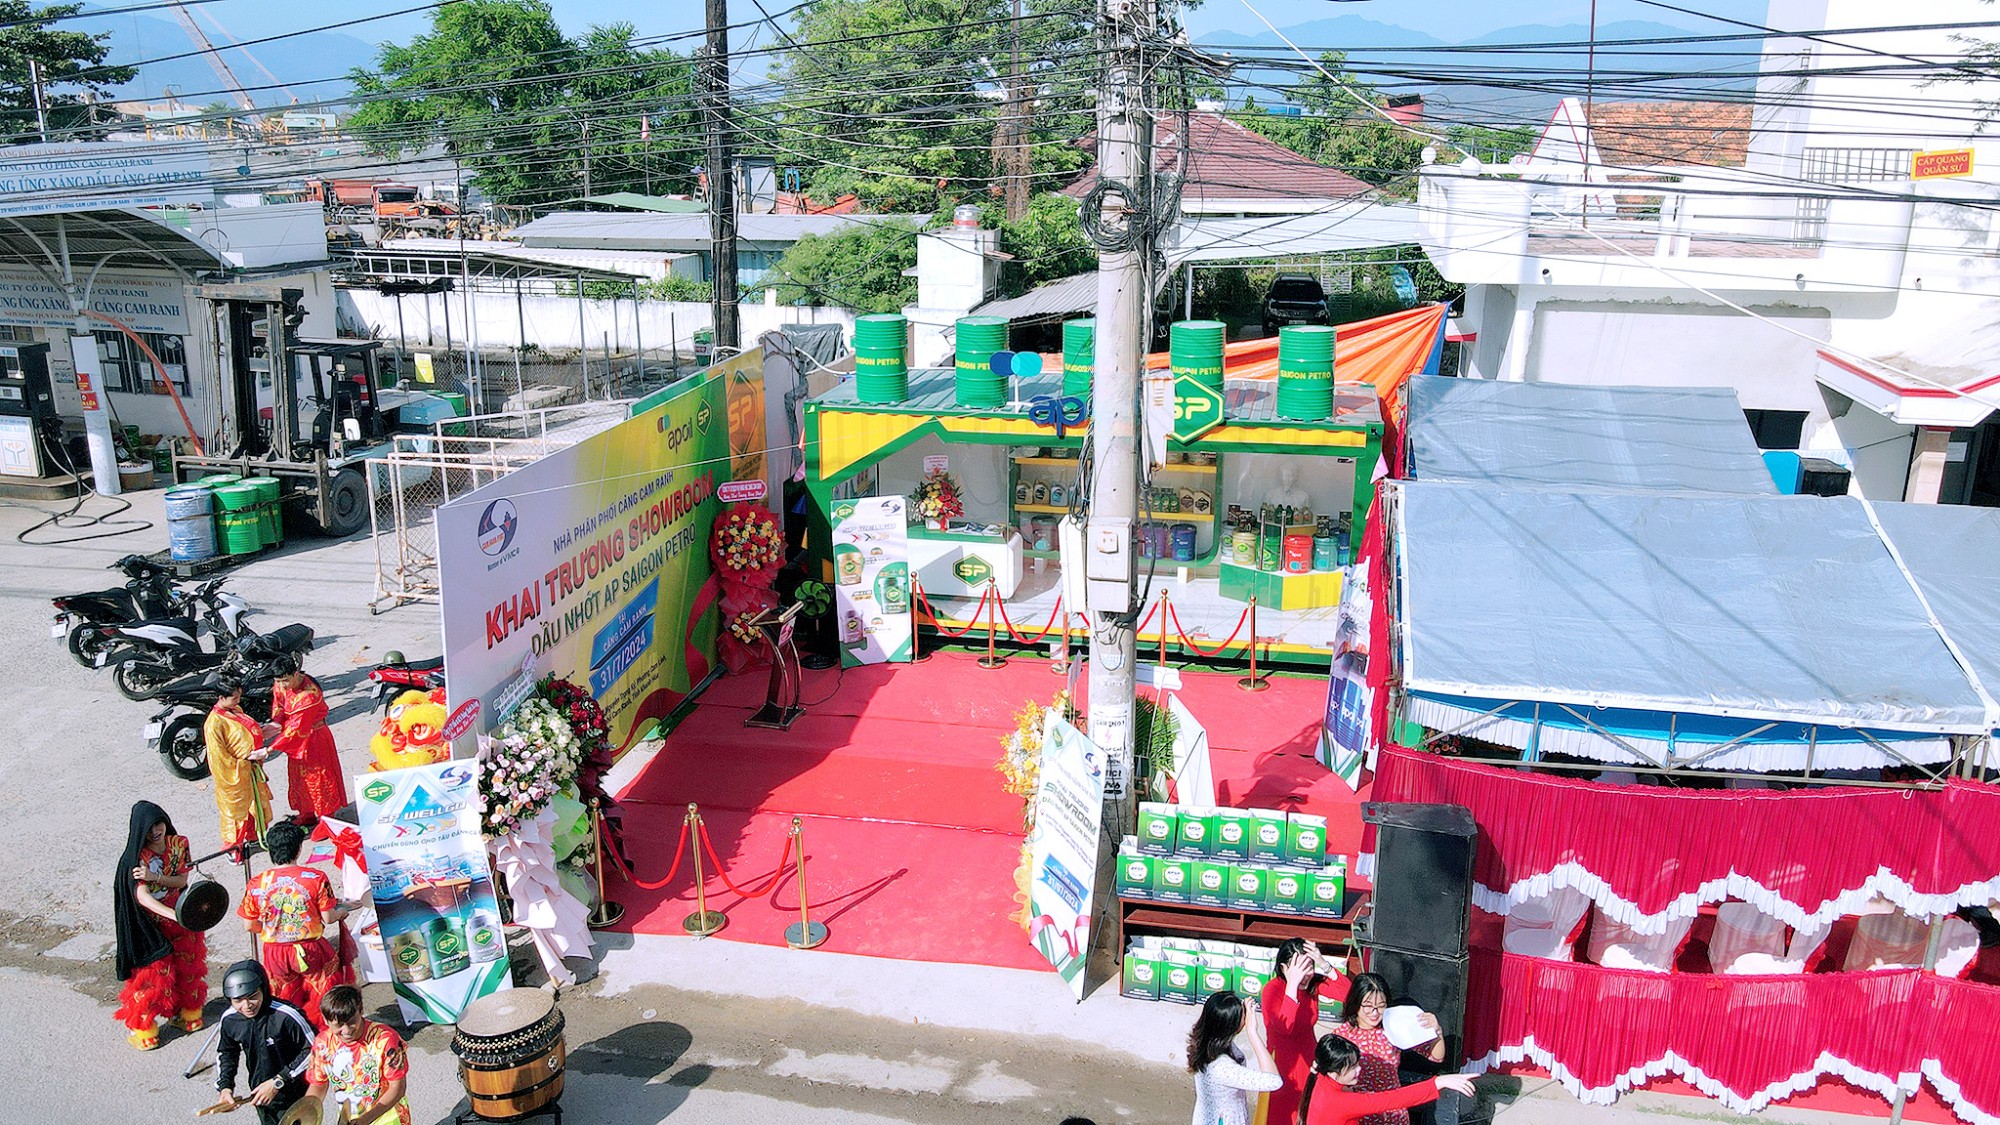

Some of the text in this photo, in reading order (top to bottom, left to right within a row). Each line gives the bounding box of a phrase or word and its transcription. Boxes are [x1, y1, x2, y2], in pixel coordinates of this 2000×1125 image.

[1936, 155, 1967, 165] QUANG
[1923, 164, 1962, 175] QUÂN SỰ
[0, 179, 16, 192] NG
[19, 175, 47, 191] ỨNG
[48, 174, 84, 188] XĂNG
[121, 289, 149, 297] RANH
[0, 297, 17, 308] NG
[95, 298, 123, 313] CẢNG
[125, 303, 148, 314] CAM
[150, 304, 180, 316] RANH
[877, 358, 900, 366] PETRO
[978, 363, 991, 371] PET
[1199, 366, 1222, 375] PETRO
[1280, 369, 1331, 379] SAIGON PETRO
[698, 408, 710, 427] SP
[668, 417, 693, 454] apoil
[553, 470, 673, 555] NHÀ PHÂN PHỐI CẢNG CAM RANH
[486, 579, 541, 651] KHAI
[628, 467, 714, 552] SHOWROOM
[959, 563, 987, 577] SP
[531, 522, 696, 658] DẦU NHỚT AP SAIGON PETRO
[601, 629, 648, 690] 31/7/2024
[367, 786, 390, 798] SP
[1043, 781, 1098, 836] SHOWROOM
[377, 813, 400, 825] SP
[477, 931, 491, 941] SP
[440, 938, 455, 949] SP
[401, 950, 416, 960] SP
